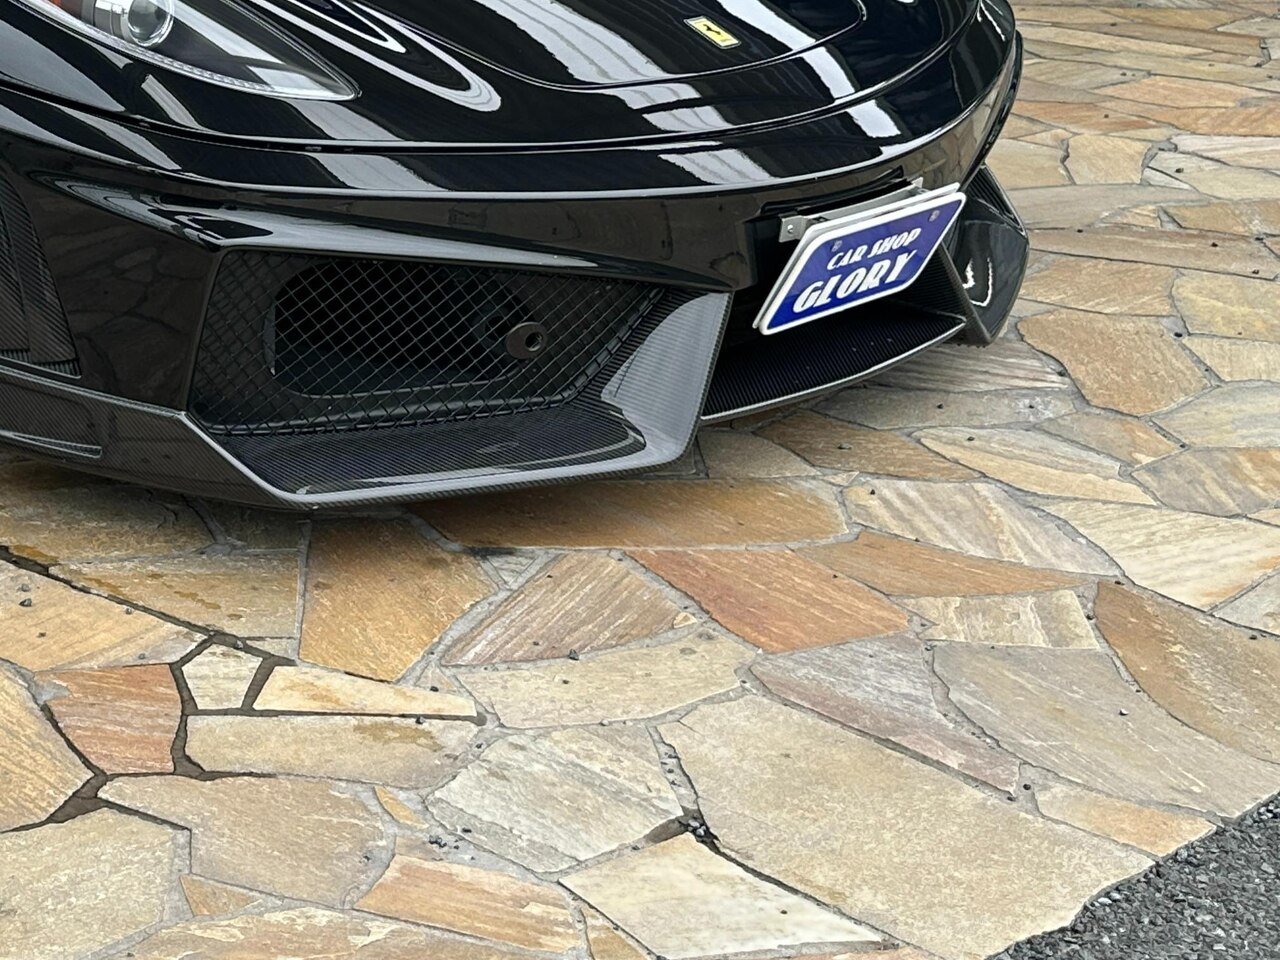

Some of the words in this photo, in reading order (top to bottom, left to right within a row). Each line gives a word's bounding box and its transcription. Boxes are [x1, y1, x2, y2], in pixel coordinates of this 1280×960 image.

[827, 244, 867, 270] CAR
[867, 228, 922, 259] SHOP
[792, 250, 917, 313] GLORY
